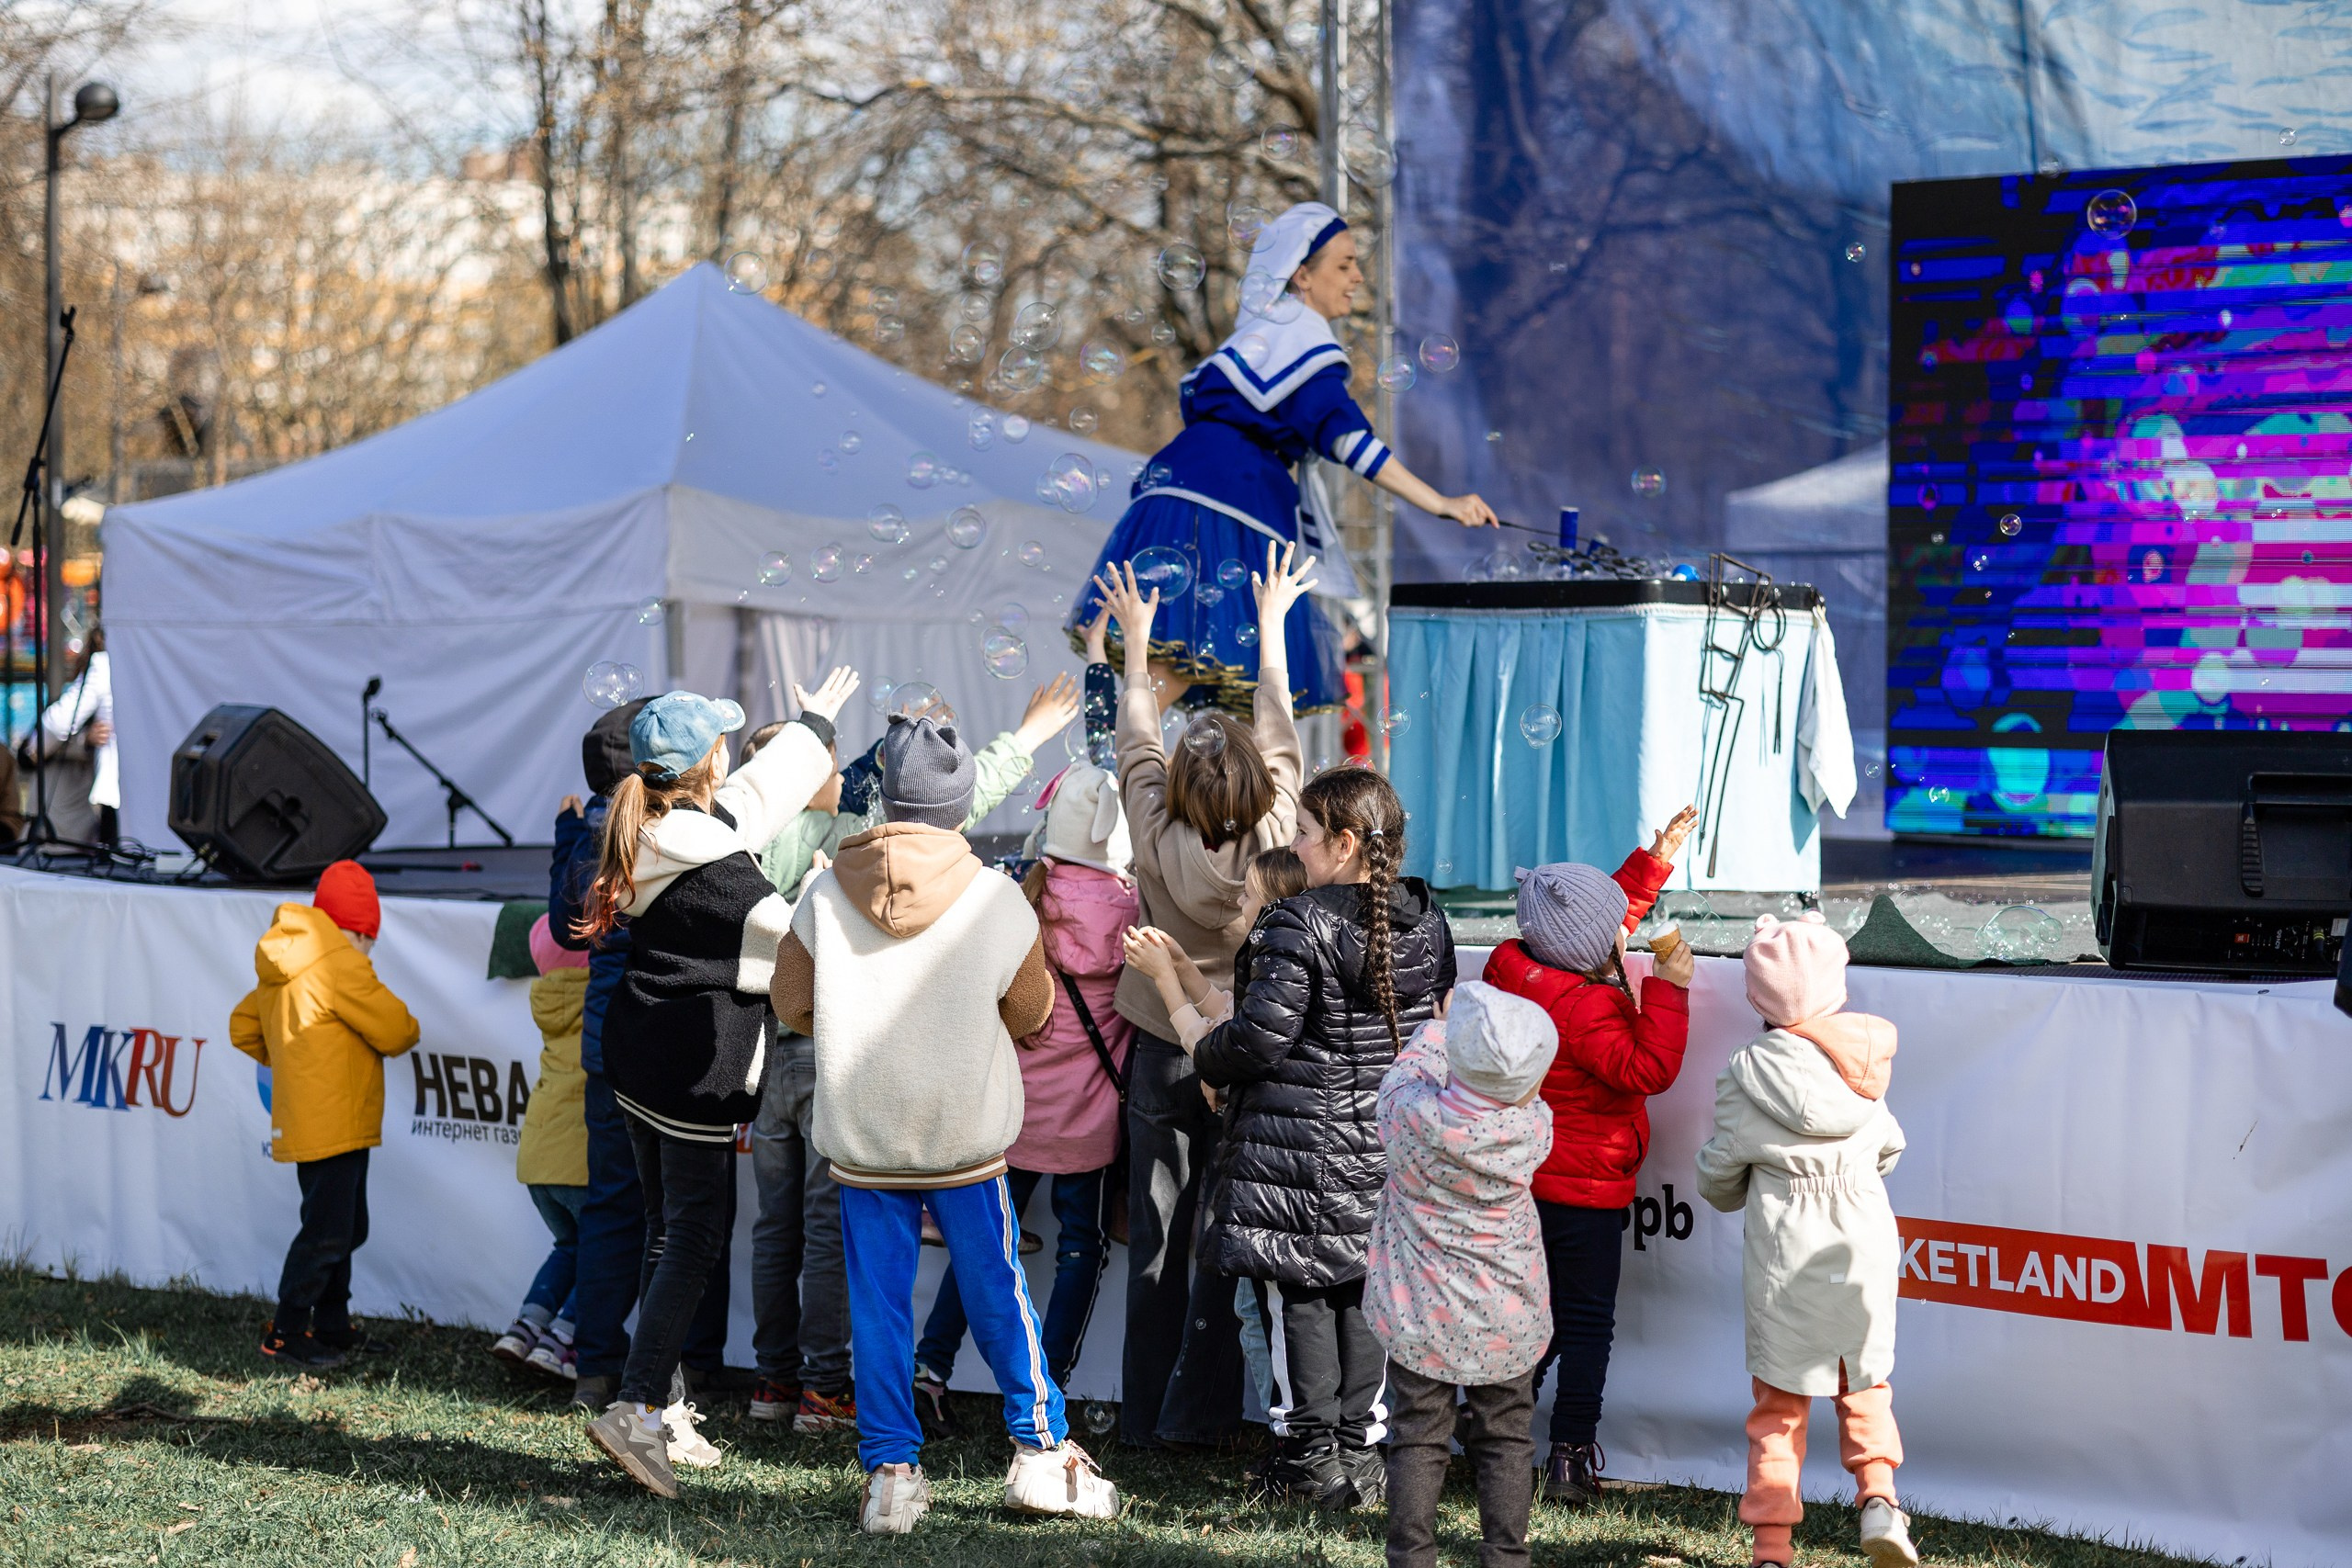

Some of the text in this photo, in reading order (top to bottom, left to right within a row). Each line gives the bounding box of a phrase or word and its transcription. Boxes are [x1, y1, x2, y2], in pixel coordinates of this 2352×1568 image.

[40, 1021, 208, 1119] MKRU
[411, 1052, 530, 1126] НЕВА
[411, 1119, 521, 1145] интернет газ
